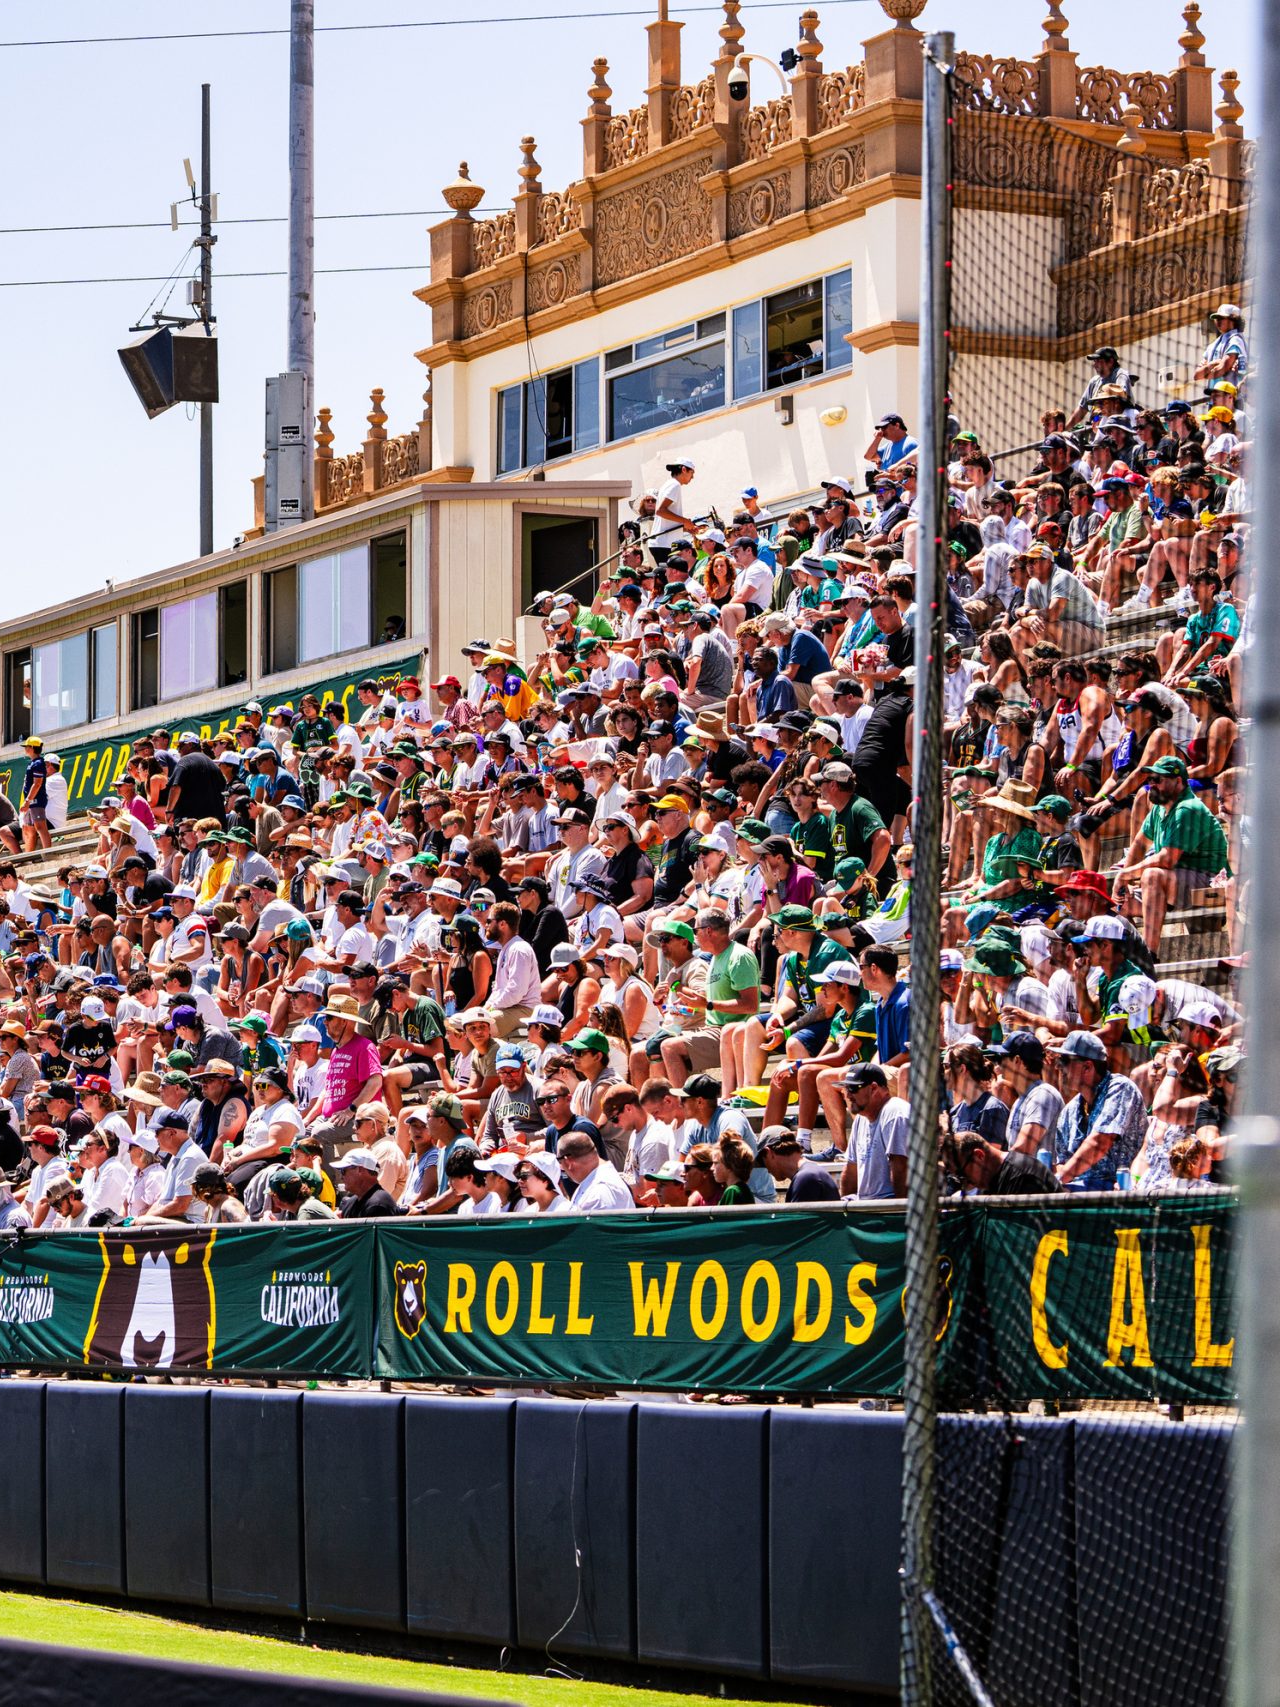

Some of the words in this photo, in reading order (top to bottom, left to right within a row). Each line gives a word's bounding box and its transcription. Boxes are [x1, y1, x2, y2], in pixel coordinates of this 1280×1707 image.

[1221, 617, 1231, 632] 9
[78, 1046, 104, 1056] GWB
[495, 1101, 530, 1122] REDWOODS
[5, 1275, 43, 1285] REDWOODS
[278, 1272, 324, 1282] REDWOODS
[443, 1260, 595, 1336] ROLL
[628, 1259, 879, 1346] WOODS
[1030, 1225, 1235, 1369] CAL
[261, 1285, 340, 1328] CALIFORNIA
